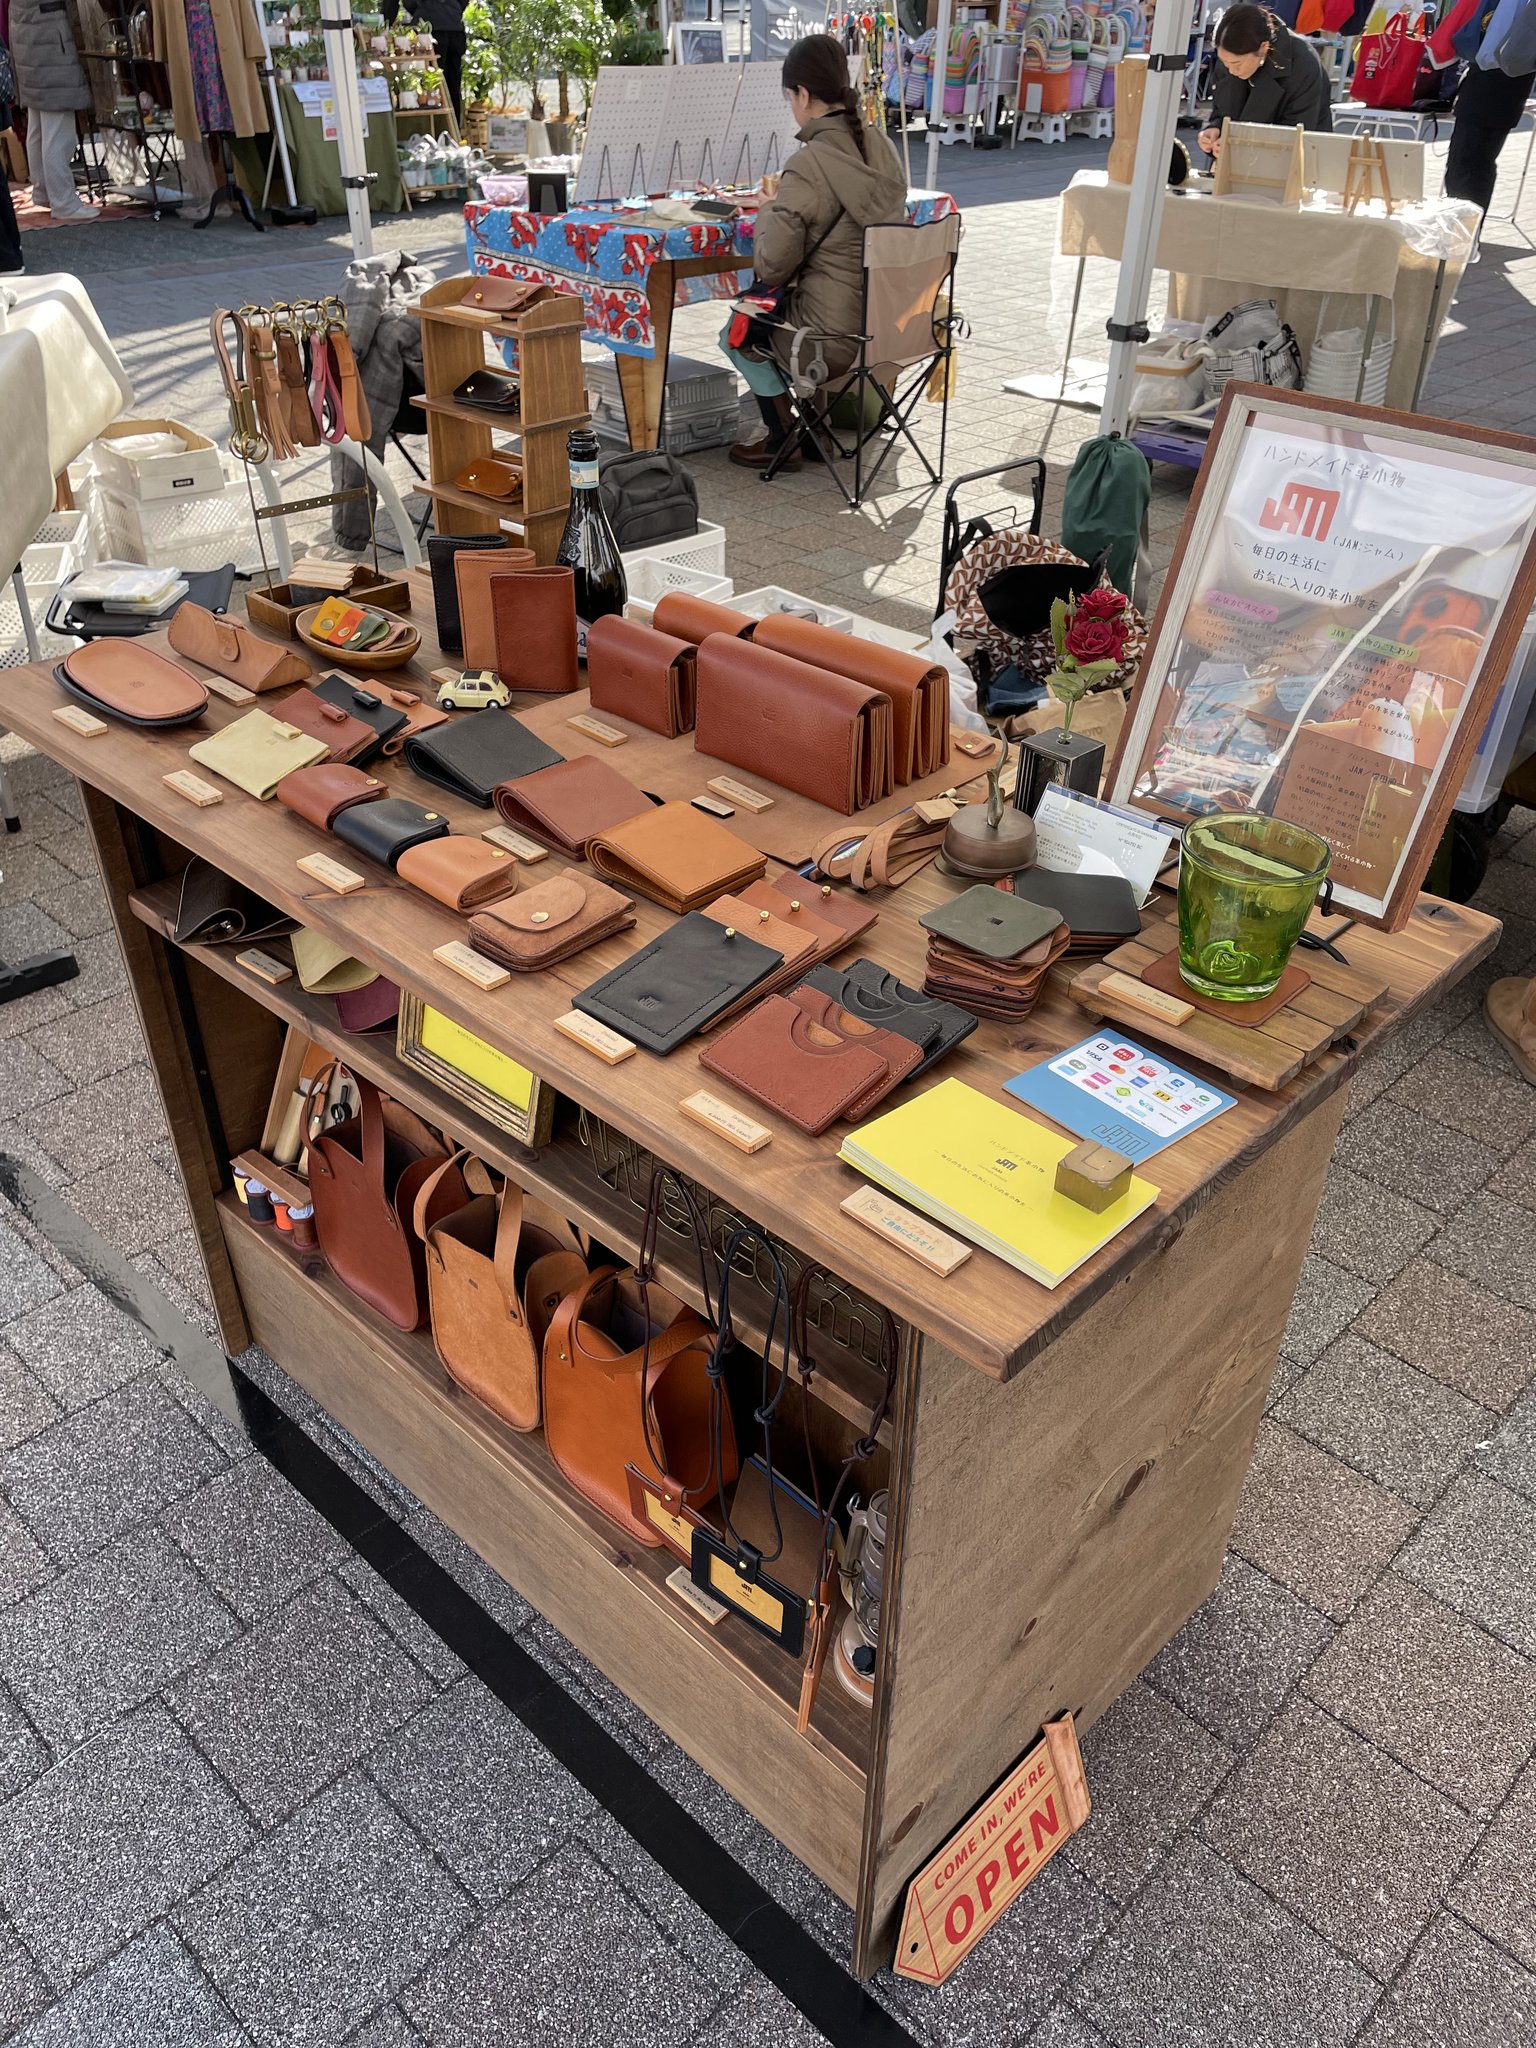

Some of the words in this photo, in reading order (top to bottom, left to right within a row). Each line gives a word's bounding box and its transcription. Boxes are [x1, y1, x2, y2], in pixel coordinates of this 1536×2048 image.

[1264, 445, 1406, 488] ハンドメイド革小物
[1258, 482, 1341, 542] JAM
[1252, 543, 1327, 573] 毎日の生活に
[1253, 568, 1379, 612] お気に入りの革小物を
[1086, 1050, 1103, 1062] VISA
[934, 1837, 976, 1891] COME
[944, 1793, 1061, 1945] OPEN
